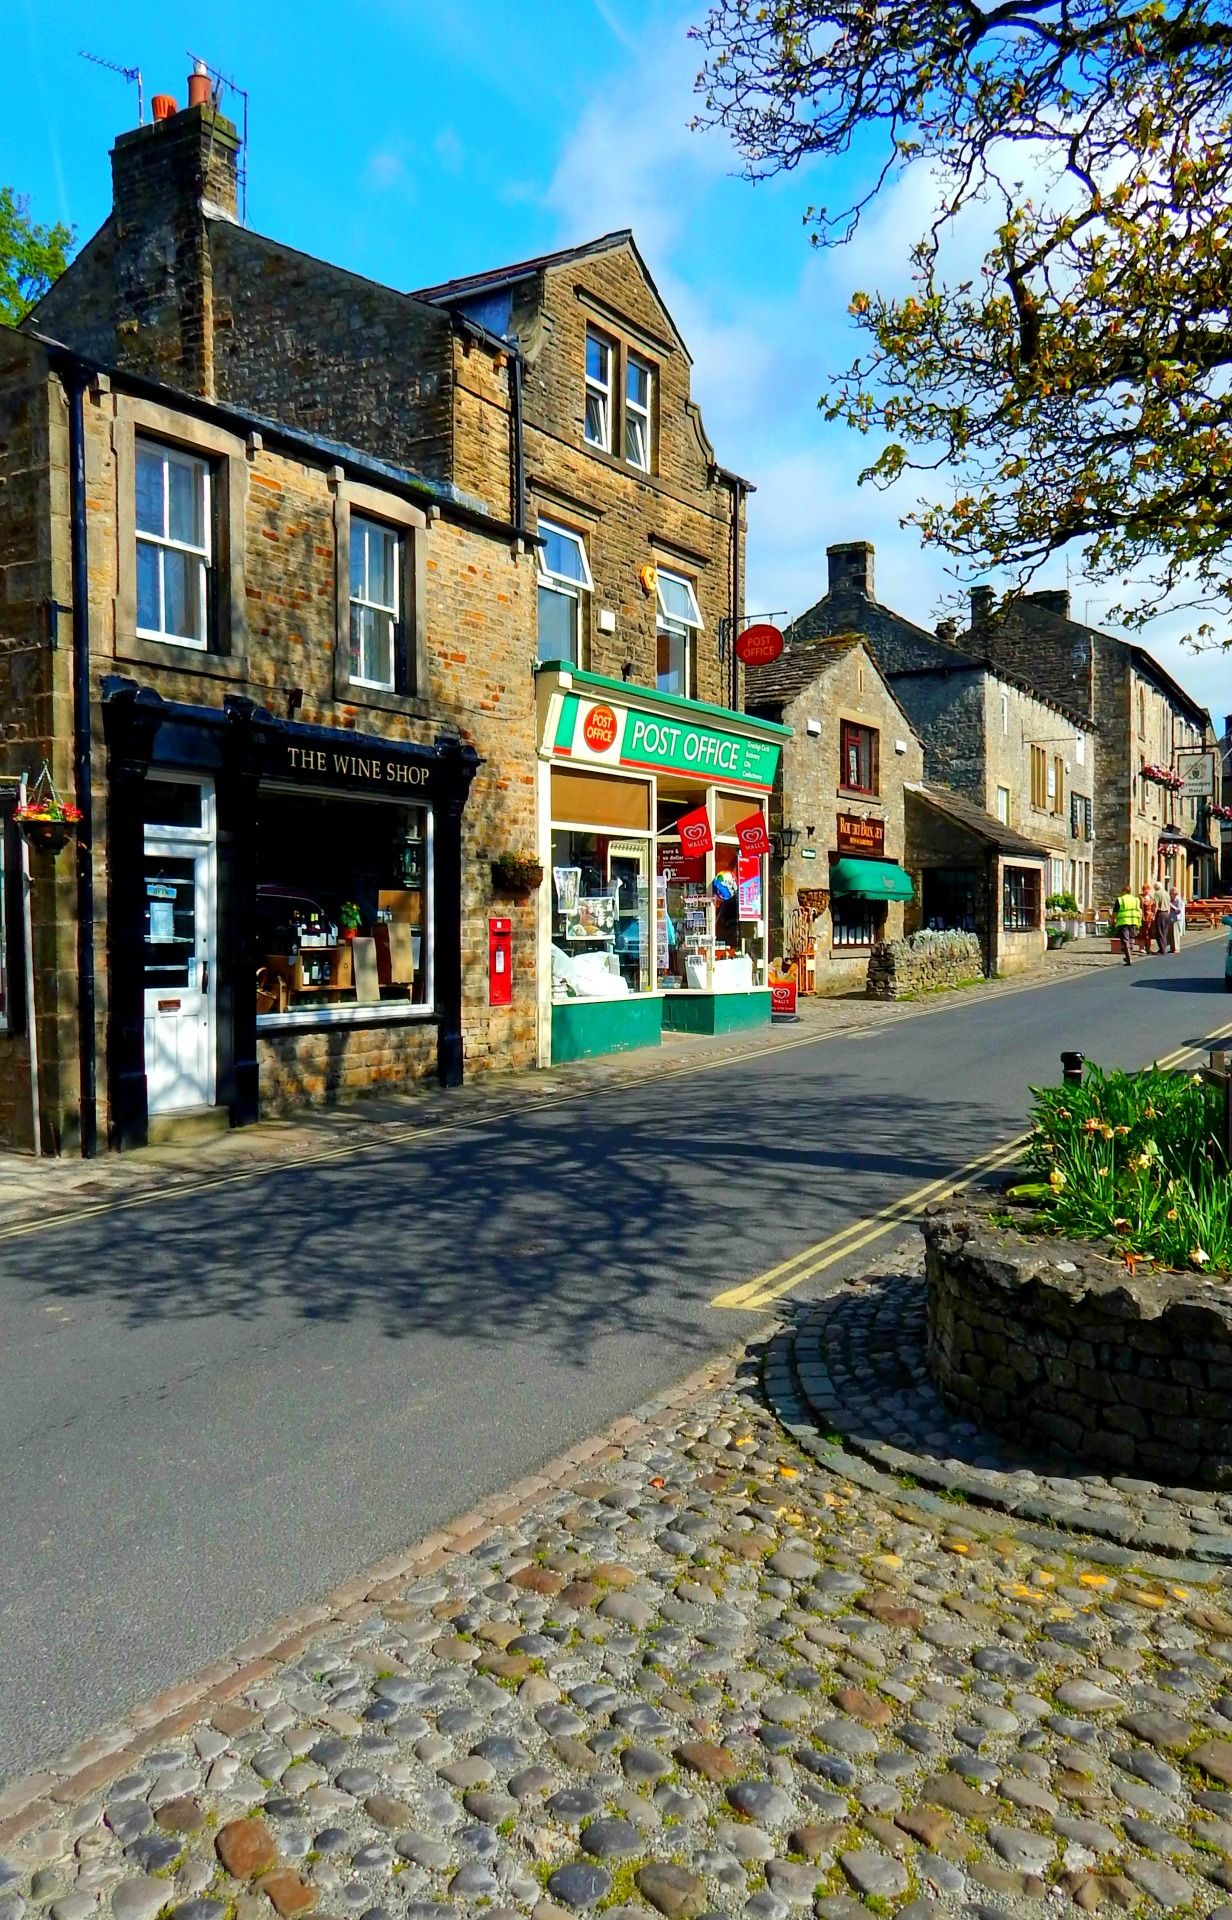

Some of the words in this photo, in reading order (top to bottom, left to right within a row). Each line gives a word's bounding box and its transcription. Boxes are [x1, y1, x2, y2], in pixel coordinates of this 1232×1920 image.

[747, 635, 771, 647] POST
[743, 646, 774, 658] OFFICE
[592, 714, 613, 729] POST
[587, 727, 613, 743] OFFICE
[632, 720, 682, 757] POST
[683, 733, 740, 770] OFFICE
[288, 747, 327, 771] THE
[333, 754, 382, 779] WINE
[387, 762, 430, 786] SHOP
[687, 838, 708, 849] WALL'S
[745, 841, 766, 851] WALL'S
